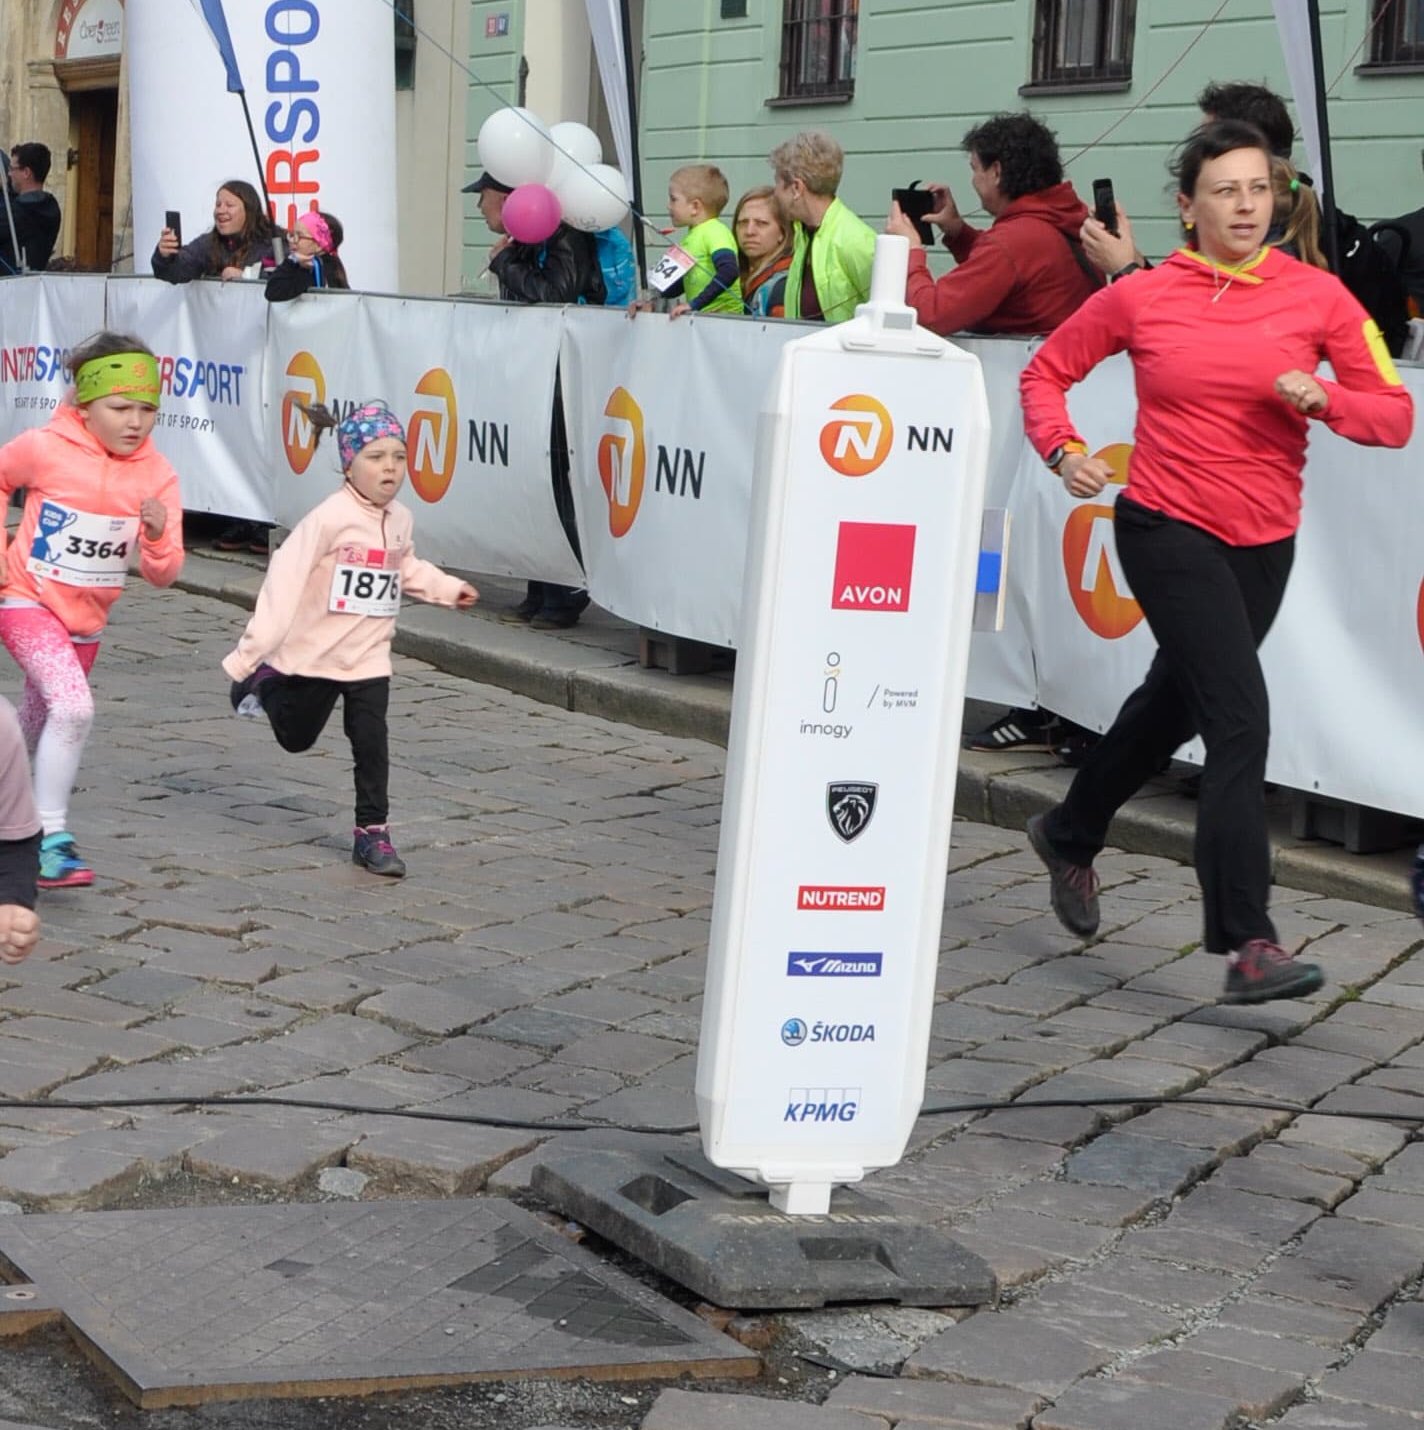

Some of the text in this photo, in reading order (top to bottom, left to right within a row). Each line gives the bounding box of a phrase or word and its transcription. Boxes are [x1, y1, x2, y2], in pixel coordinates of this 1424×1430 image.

[160, 356, 243, 407] RSPORT
[468, 419, 509, 467] NN
[907, 425, 953, 453] NN
[655, 445, 706, 499] NN
[65, 535, 128, 559] 3364
[341, 569, 399, 601] 1876
[840, 585, 902, 604] AVON
[883, 699, 917, 709] by MVM
[884, 688, 919, 698] Powered
[799, 720, 853, 739] innogy
[802, 890, 882, 907] NUTREND
[809, 1020, 876, 1043] ŠKODA
[783, 1101, 857, 1123] KPMG
